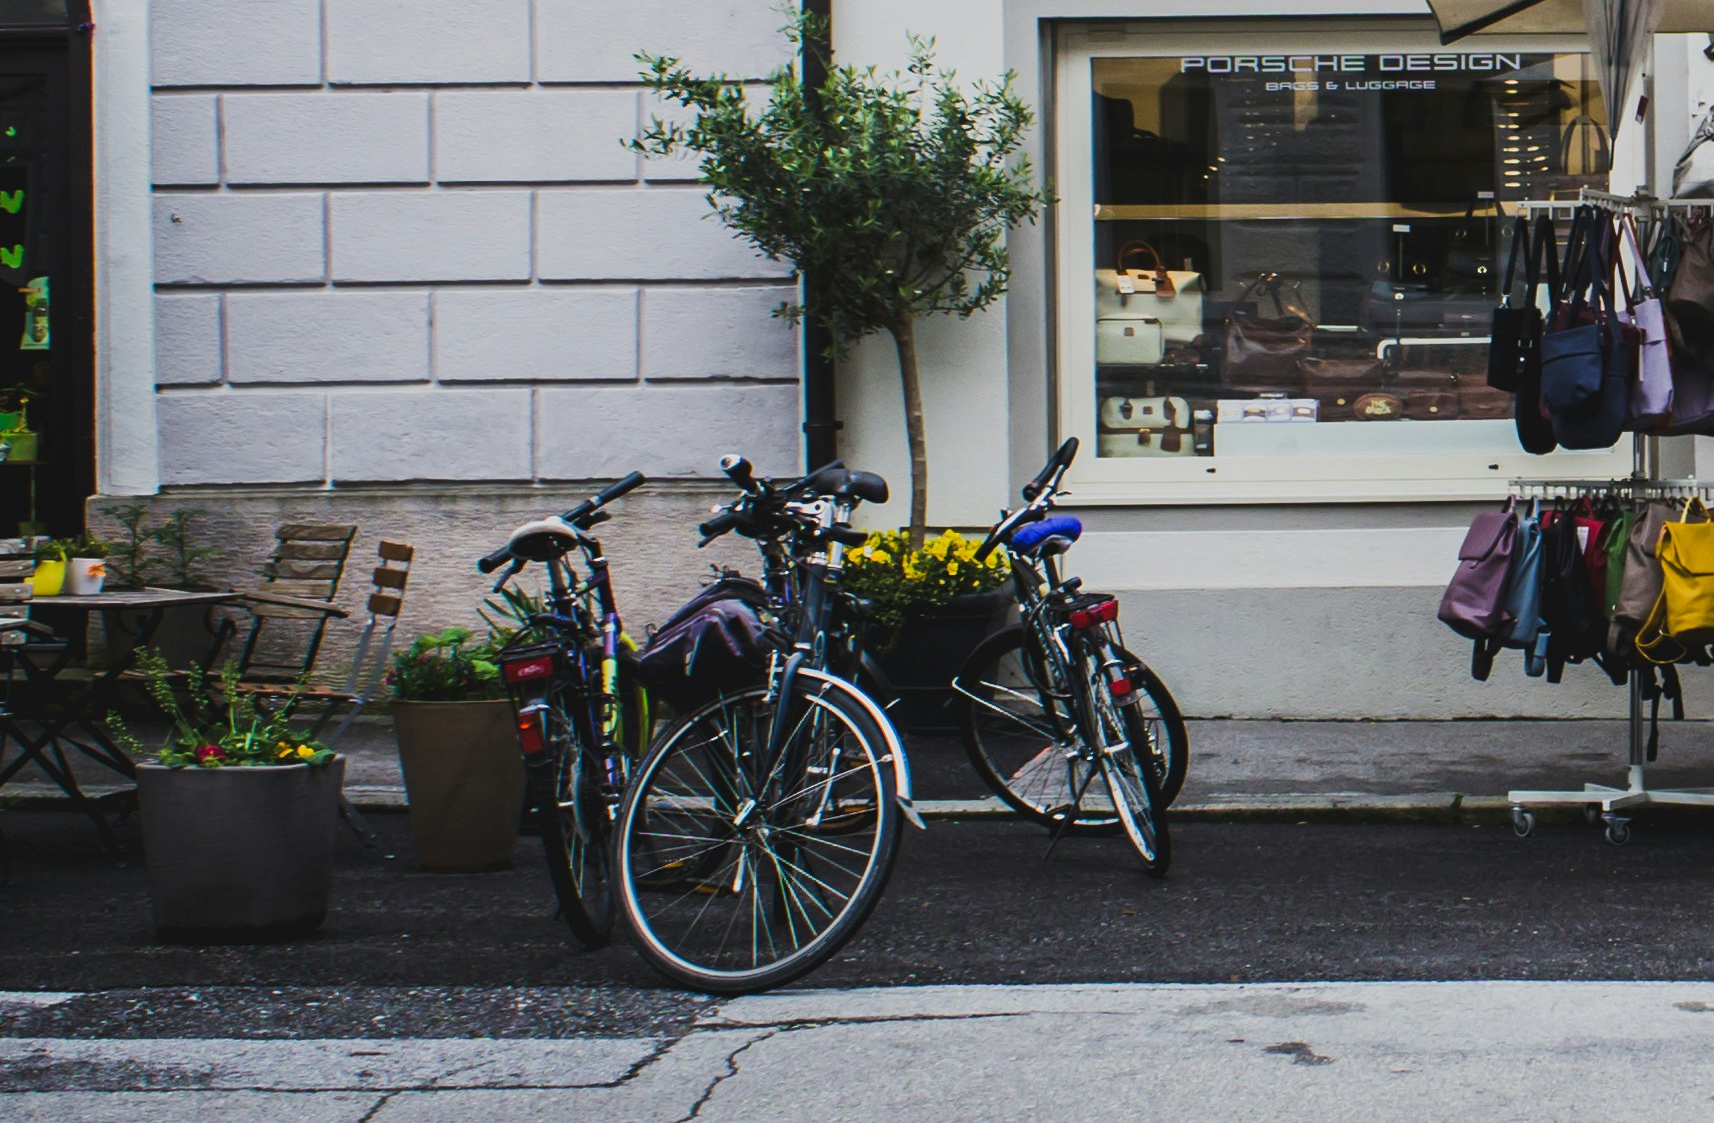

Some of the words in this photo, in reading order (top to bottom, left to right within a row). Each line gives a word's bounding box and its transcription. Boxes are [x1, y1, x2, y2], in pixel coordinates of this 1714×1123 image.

[1180, 54, 1366, 74] PORSCHE
[1379, 52, 1522, 72] DESIGN
[1265, 81, 1320, 91] BAGS
[1325, 81, 1339, 91] &
[1345, 80, 1437, 91] LUGGAGE
